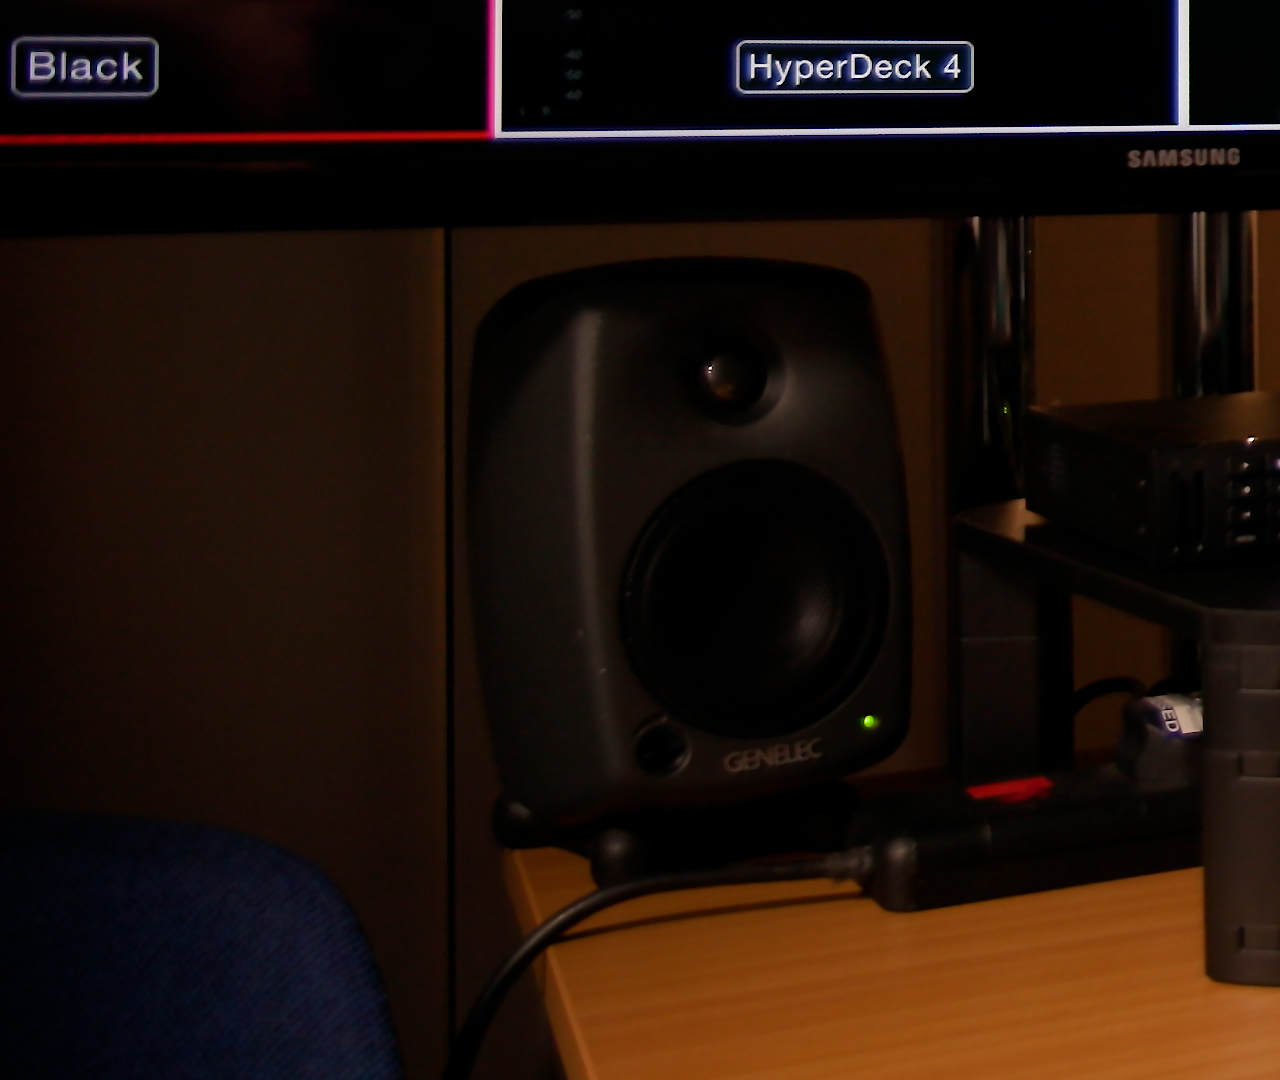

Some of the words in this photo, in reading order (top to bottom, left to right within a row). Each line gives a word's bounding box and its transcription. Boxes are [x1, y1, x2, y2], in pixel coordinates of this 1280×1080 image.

[29, 51, 144, 81] Black
[750, 53, 932, 86] HyperDeck
[943, 53, 961, 80] 4
[1127, 147, 1241, 168] SAMSUNG
[723, 737, 824, 774] GENELEC
